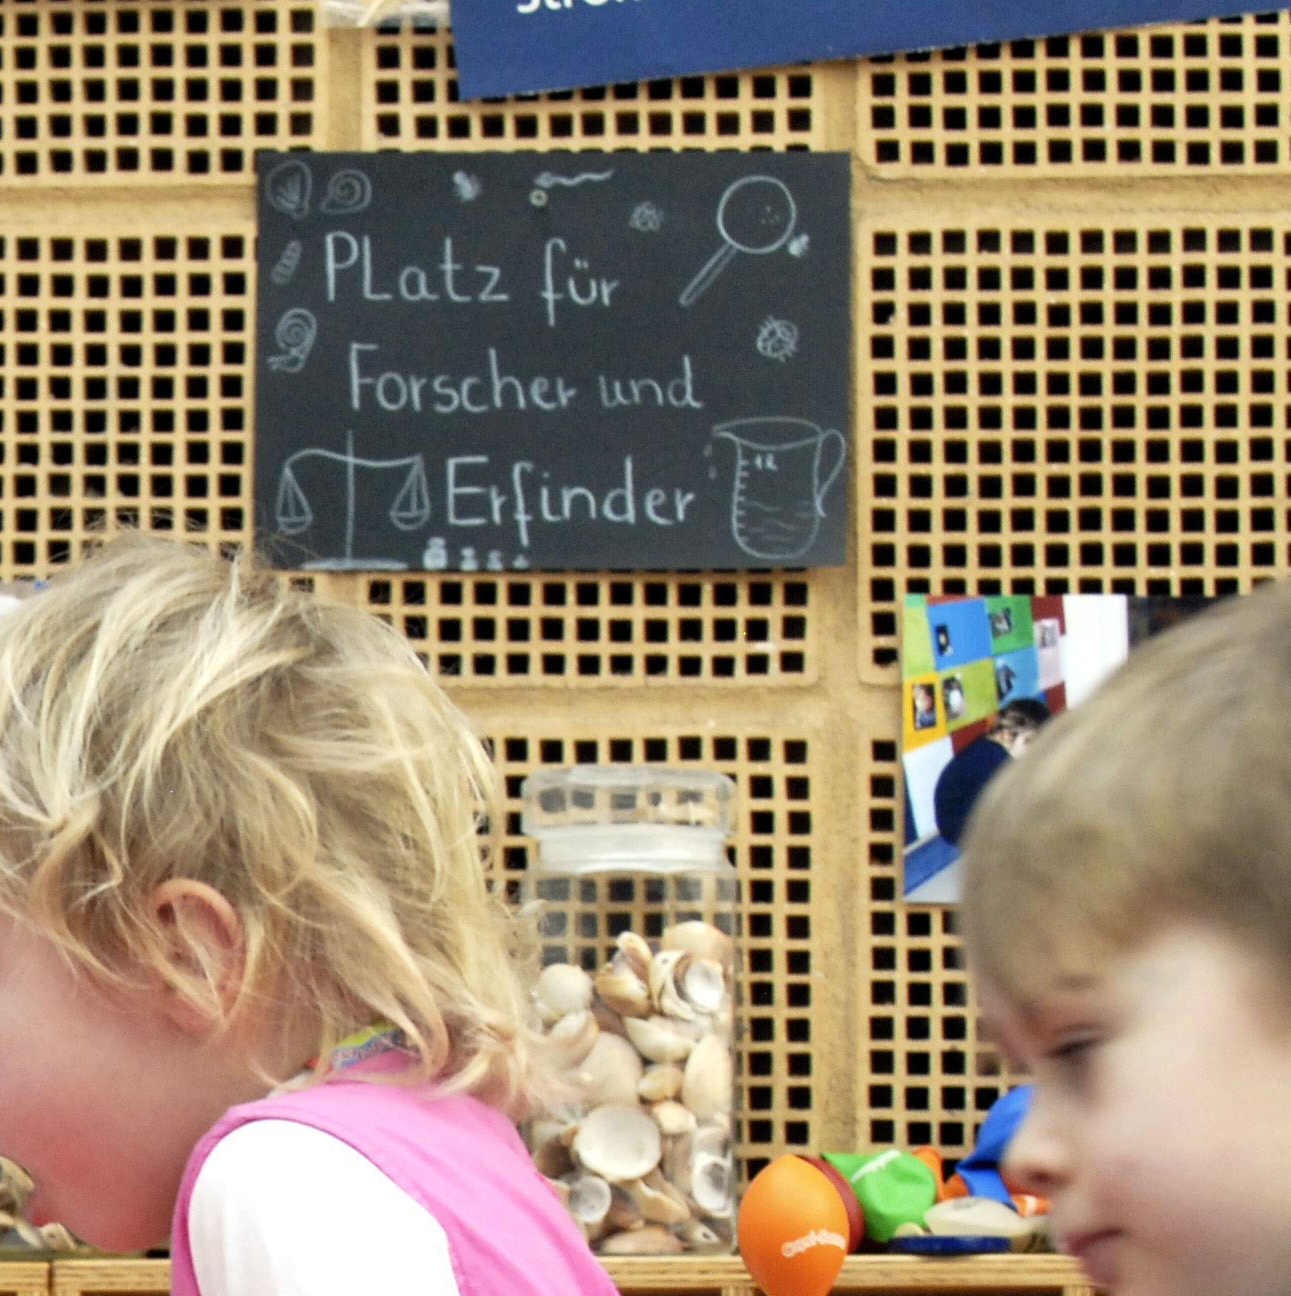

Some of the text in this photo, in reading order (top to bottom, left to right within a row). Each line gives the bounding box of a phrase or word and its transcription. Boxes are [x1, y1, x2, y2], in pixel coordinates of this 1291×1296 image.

[540, 238, 621, 326] für
[348, 342, 703, 412] Forscher und
[445, 454, 696, 547] Erfinder
